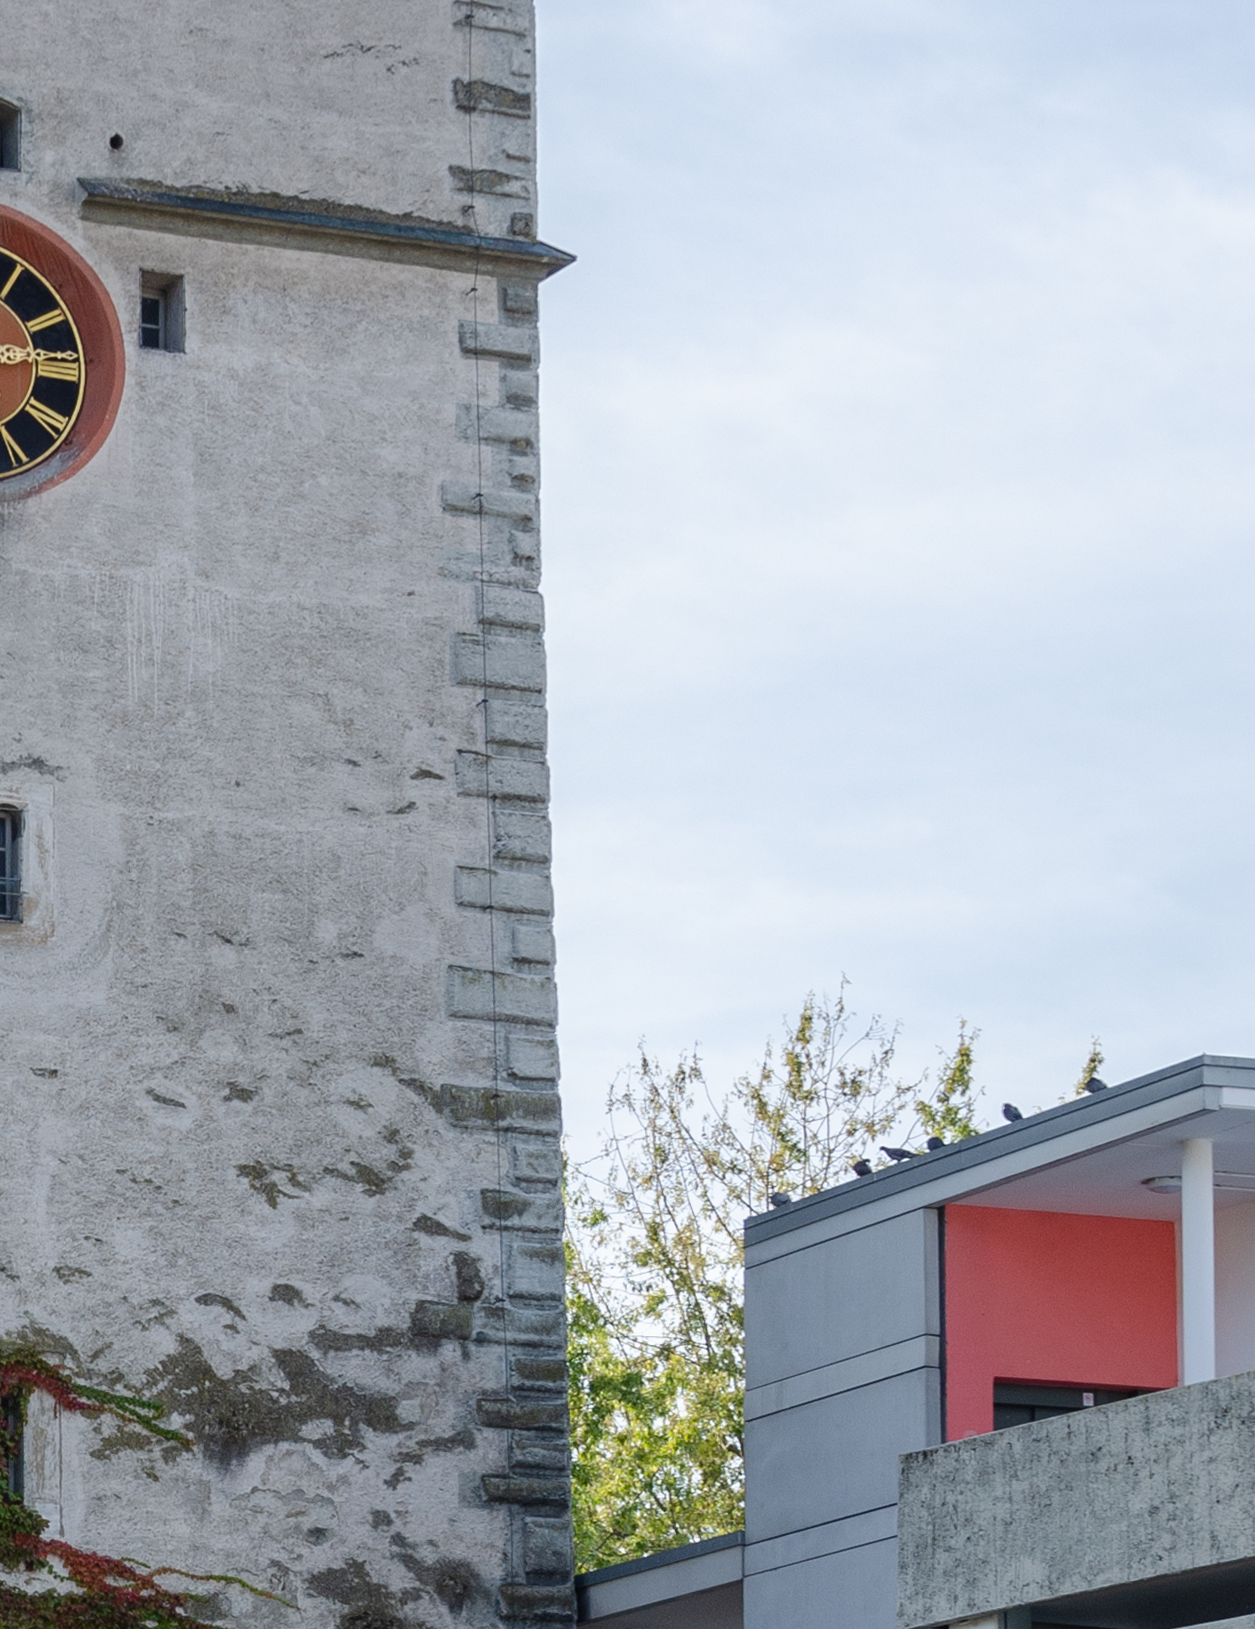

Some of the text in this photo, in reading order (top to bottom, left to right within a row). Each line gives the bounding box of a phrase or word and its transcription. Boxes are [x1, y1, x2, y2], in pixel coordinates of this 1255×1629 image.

[0, 263, 25, 299] I
[26, 308, 66, 334] II
[0, 426, 29, 466] V
